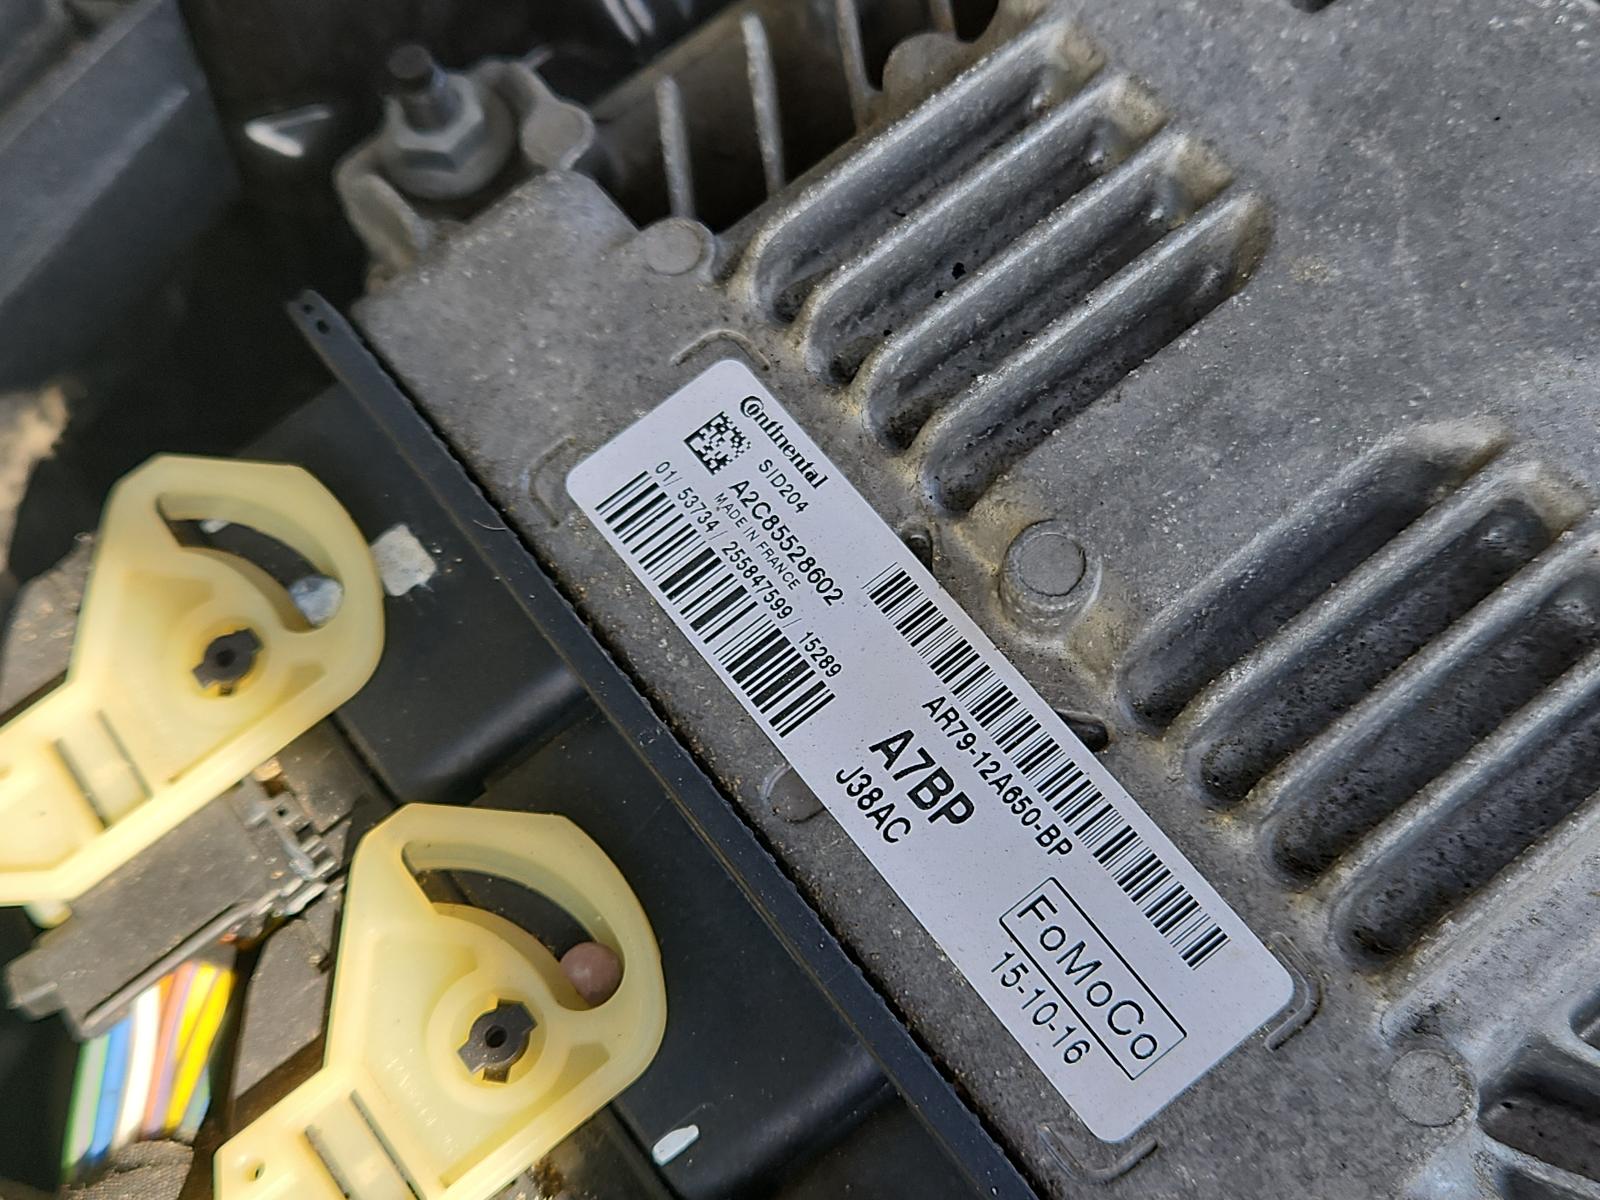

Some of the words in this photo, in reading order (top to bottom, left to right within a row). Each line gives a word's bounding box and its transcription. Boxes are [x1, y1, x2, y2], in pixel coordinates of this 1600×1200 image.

[740, 396, 829, 490] Continental
[759, 459, 809, 513] SID204
[715, 492, 748, 528] MADE
[744, 526, 760, 542] IN
[756, 541, 801, 590] FRANCE
[728, 480, 843, 606] A2C85528602
[799, 631, 842, 677] 15289
[836, 766, 911, 843] J38AC
[868, 729, 975, 824] A7BP
[922, 696, 1073, 856] AR79-12A650-BP
[991, 951, 1090, 1064] 15-10-16
